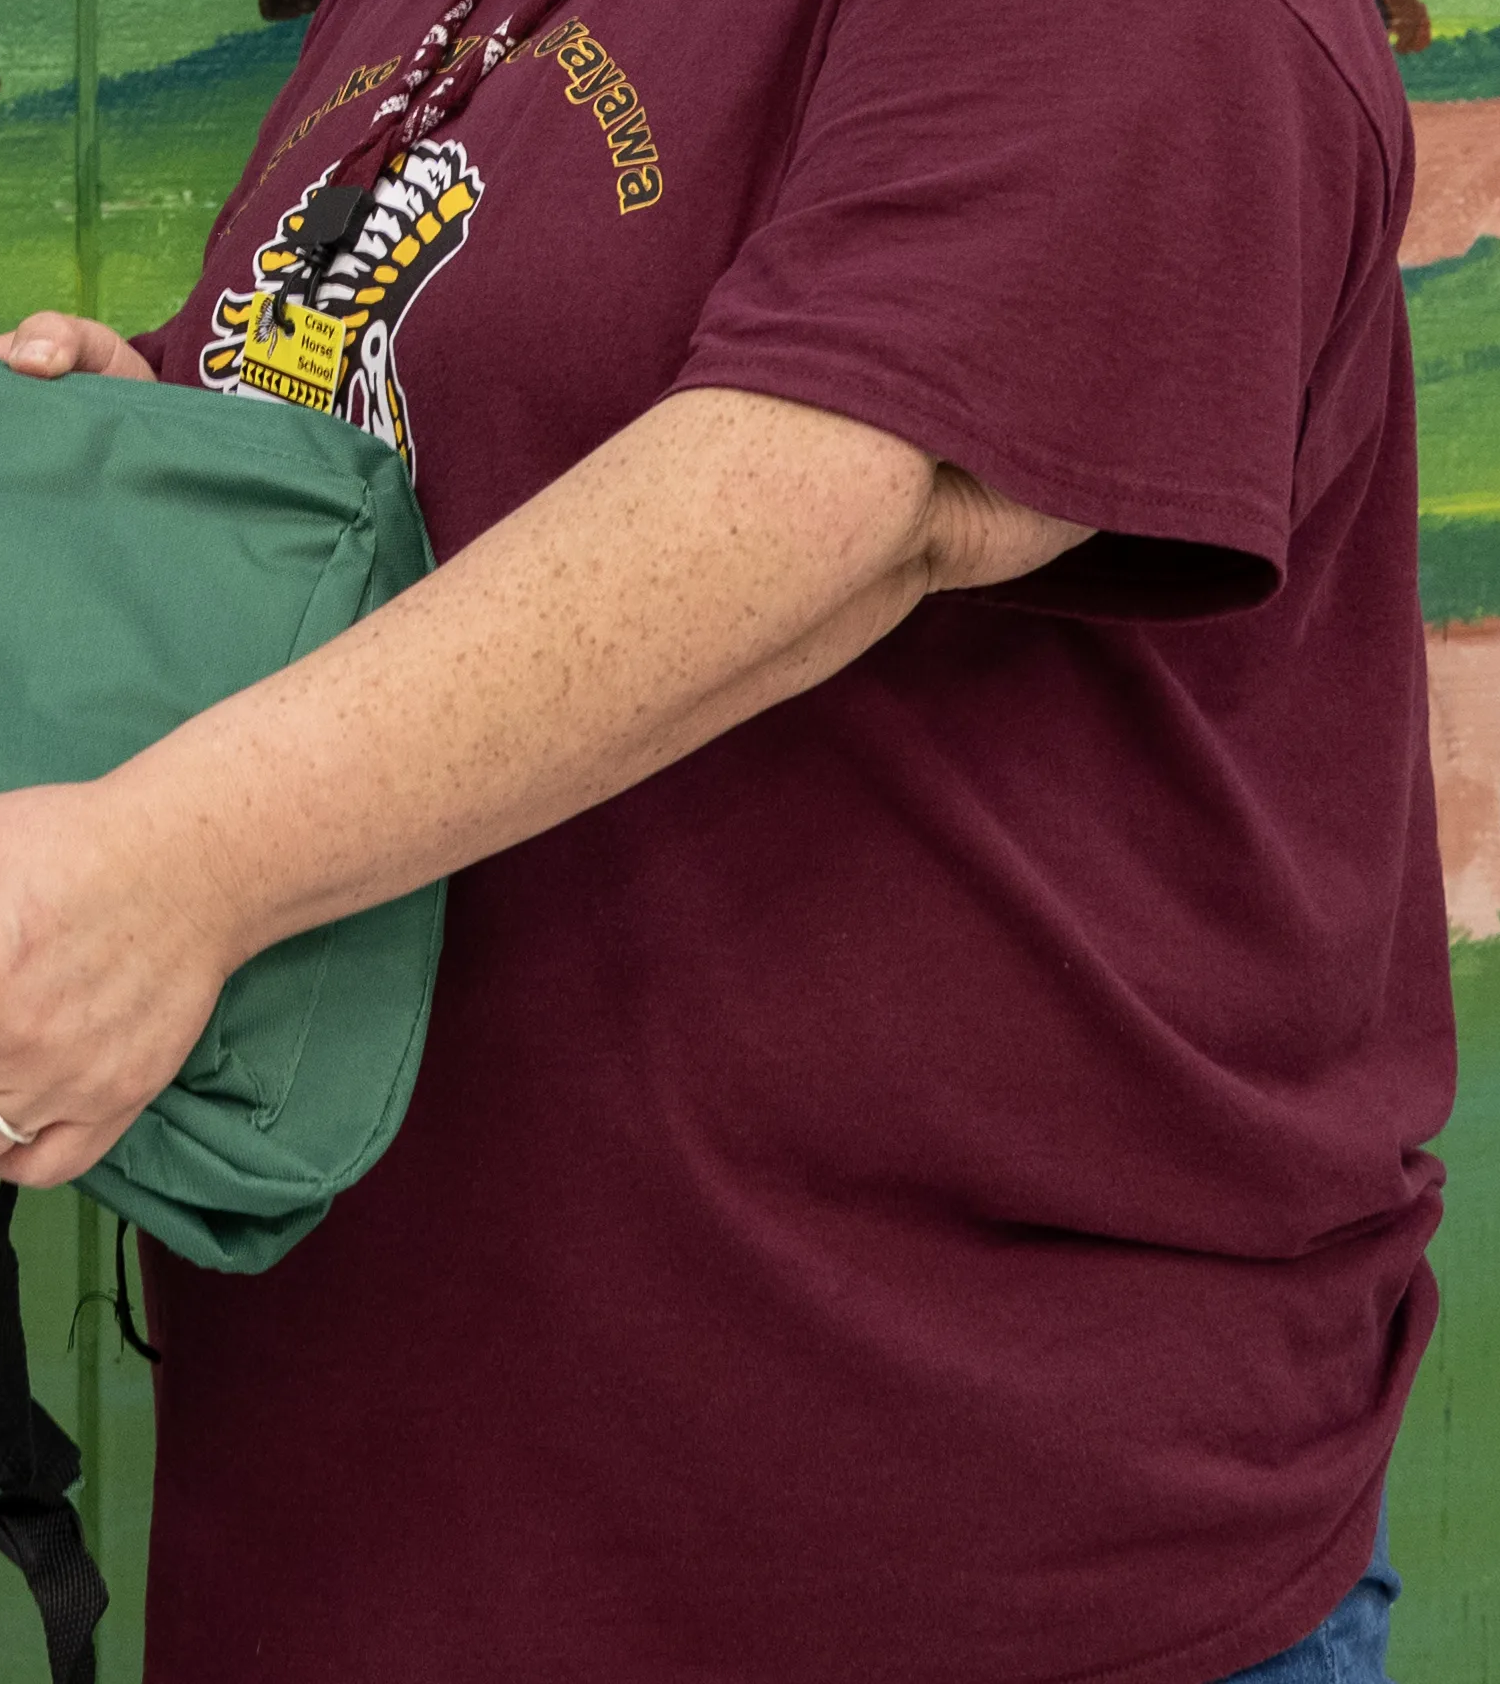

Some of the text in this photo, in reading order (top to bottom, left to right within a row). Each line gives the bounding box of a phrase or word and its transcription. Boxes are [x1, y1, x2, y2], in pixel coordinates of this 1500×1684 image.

[305, 314, 335, 338] Crazy
[302, 335, 333, 359] Horse
[298, 356, 334, 381] School
